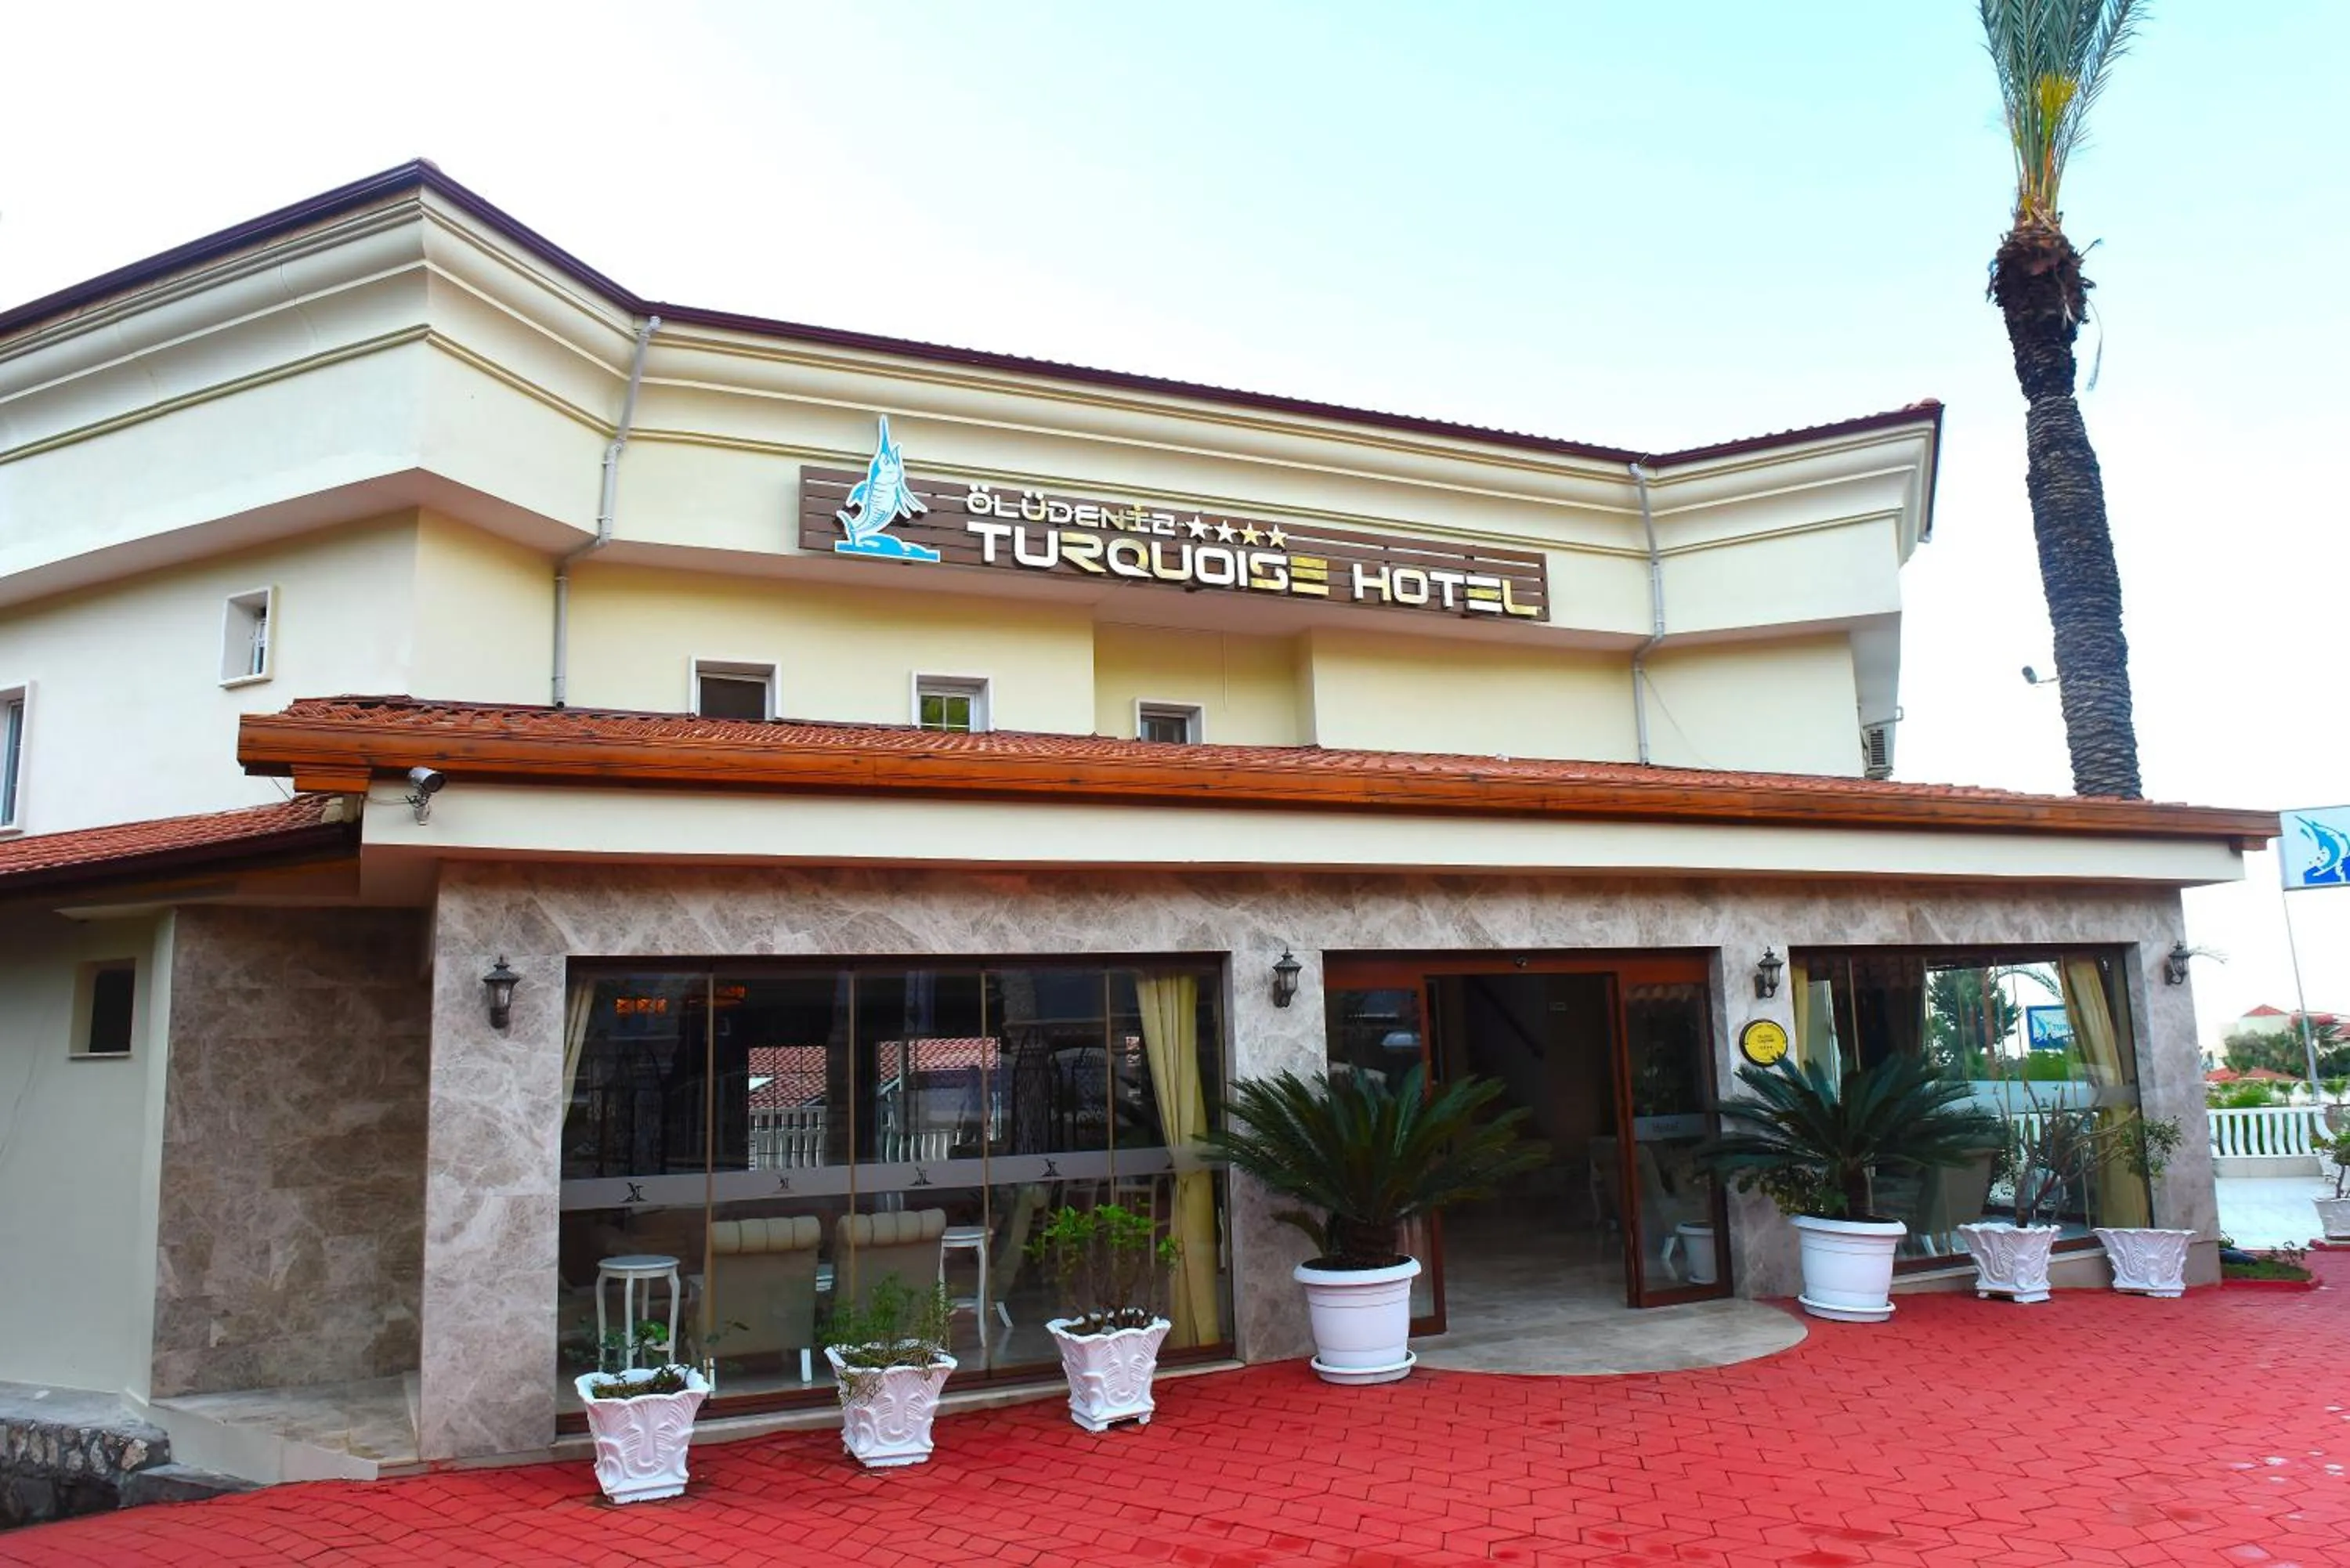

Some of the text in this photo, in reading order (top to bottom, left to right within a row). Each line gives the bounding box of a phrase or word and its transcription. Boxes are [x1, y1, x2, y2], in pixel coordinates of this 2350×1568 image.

[966, 483, 1176, 536] ÖLÜDENİZ
[966, 520, 1538, 616] TURQUOISE HOTEL
